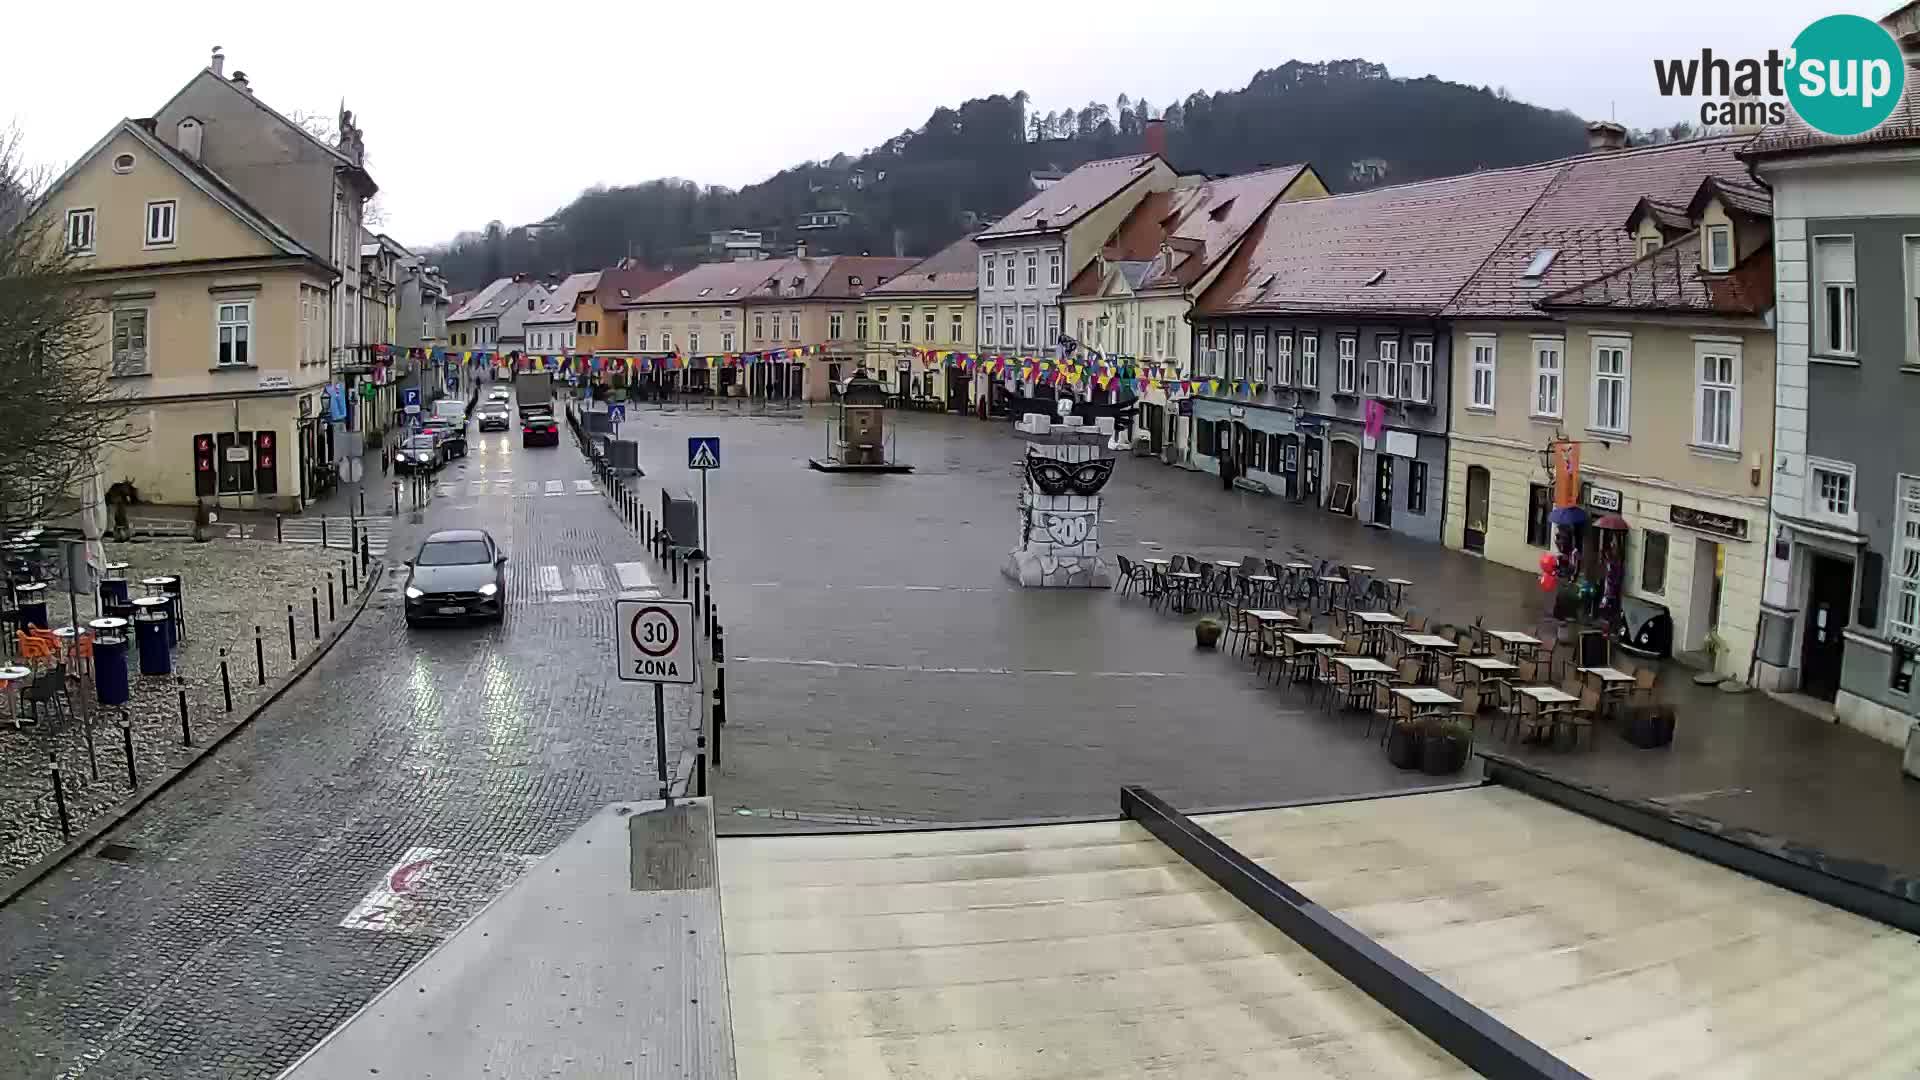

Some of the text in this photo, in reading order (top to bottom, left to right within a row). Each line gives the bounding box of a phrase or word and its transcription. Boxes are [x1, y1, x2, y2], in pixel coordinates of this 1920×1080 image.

[408, 392, 416, 402] P
[1048, 516, 1087, 545] 200
[643, 622, 667, 643] 30
[634, 659, 679, 676] ZONA
